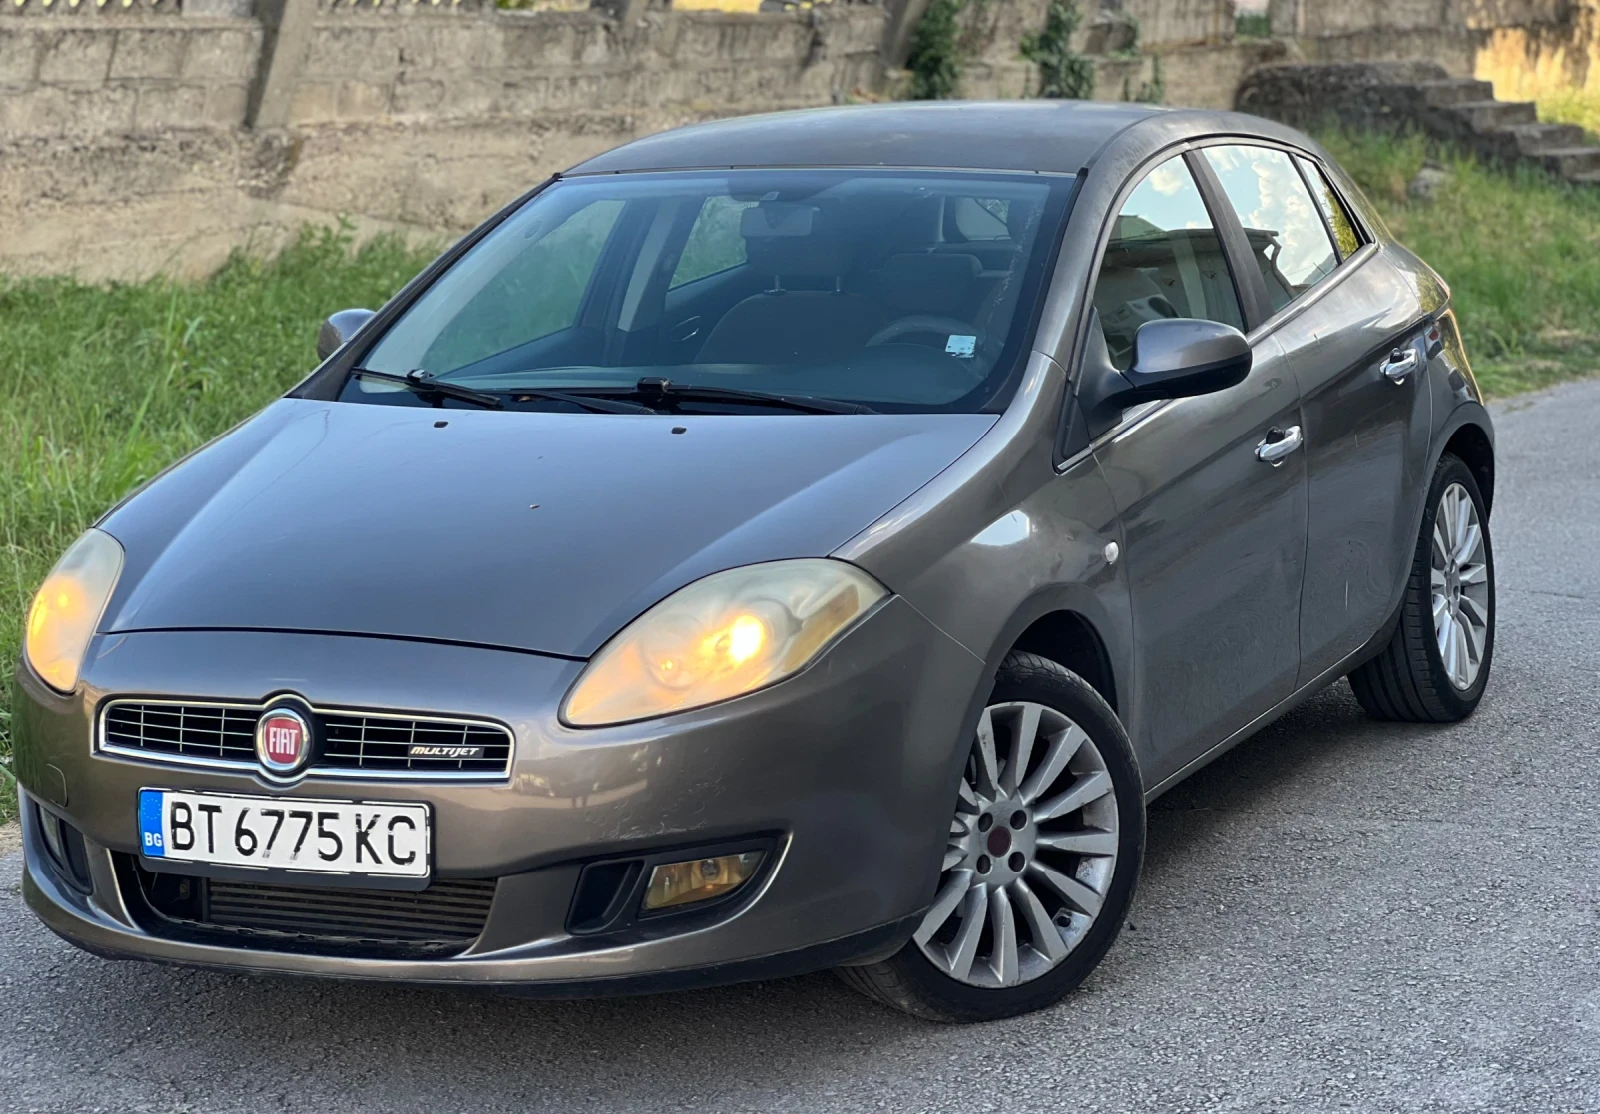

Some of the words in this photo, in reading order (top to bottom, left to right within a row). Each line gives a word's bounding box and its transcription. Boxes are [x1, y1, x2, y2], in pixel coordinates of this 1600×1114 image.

[269, 727, 298, 755] FIAT
[410, 746, 479, 757] MULTIJET
[145, 832, 162, 847] BG
[170, 801, 222, 853] BT
[234, 807, 343, 861] 6775
[355, 813, 416, 866] KC
